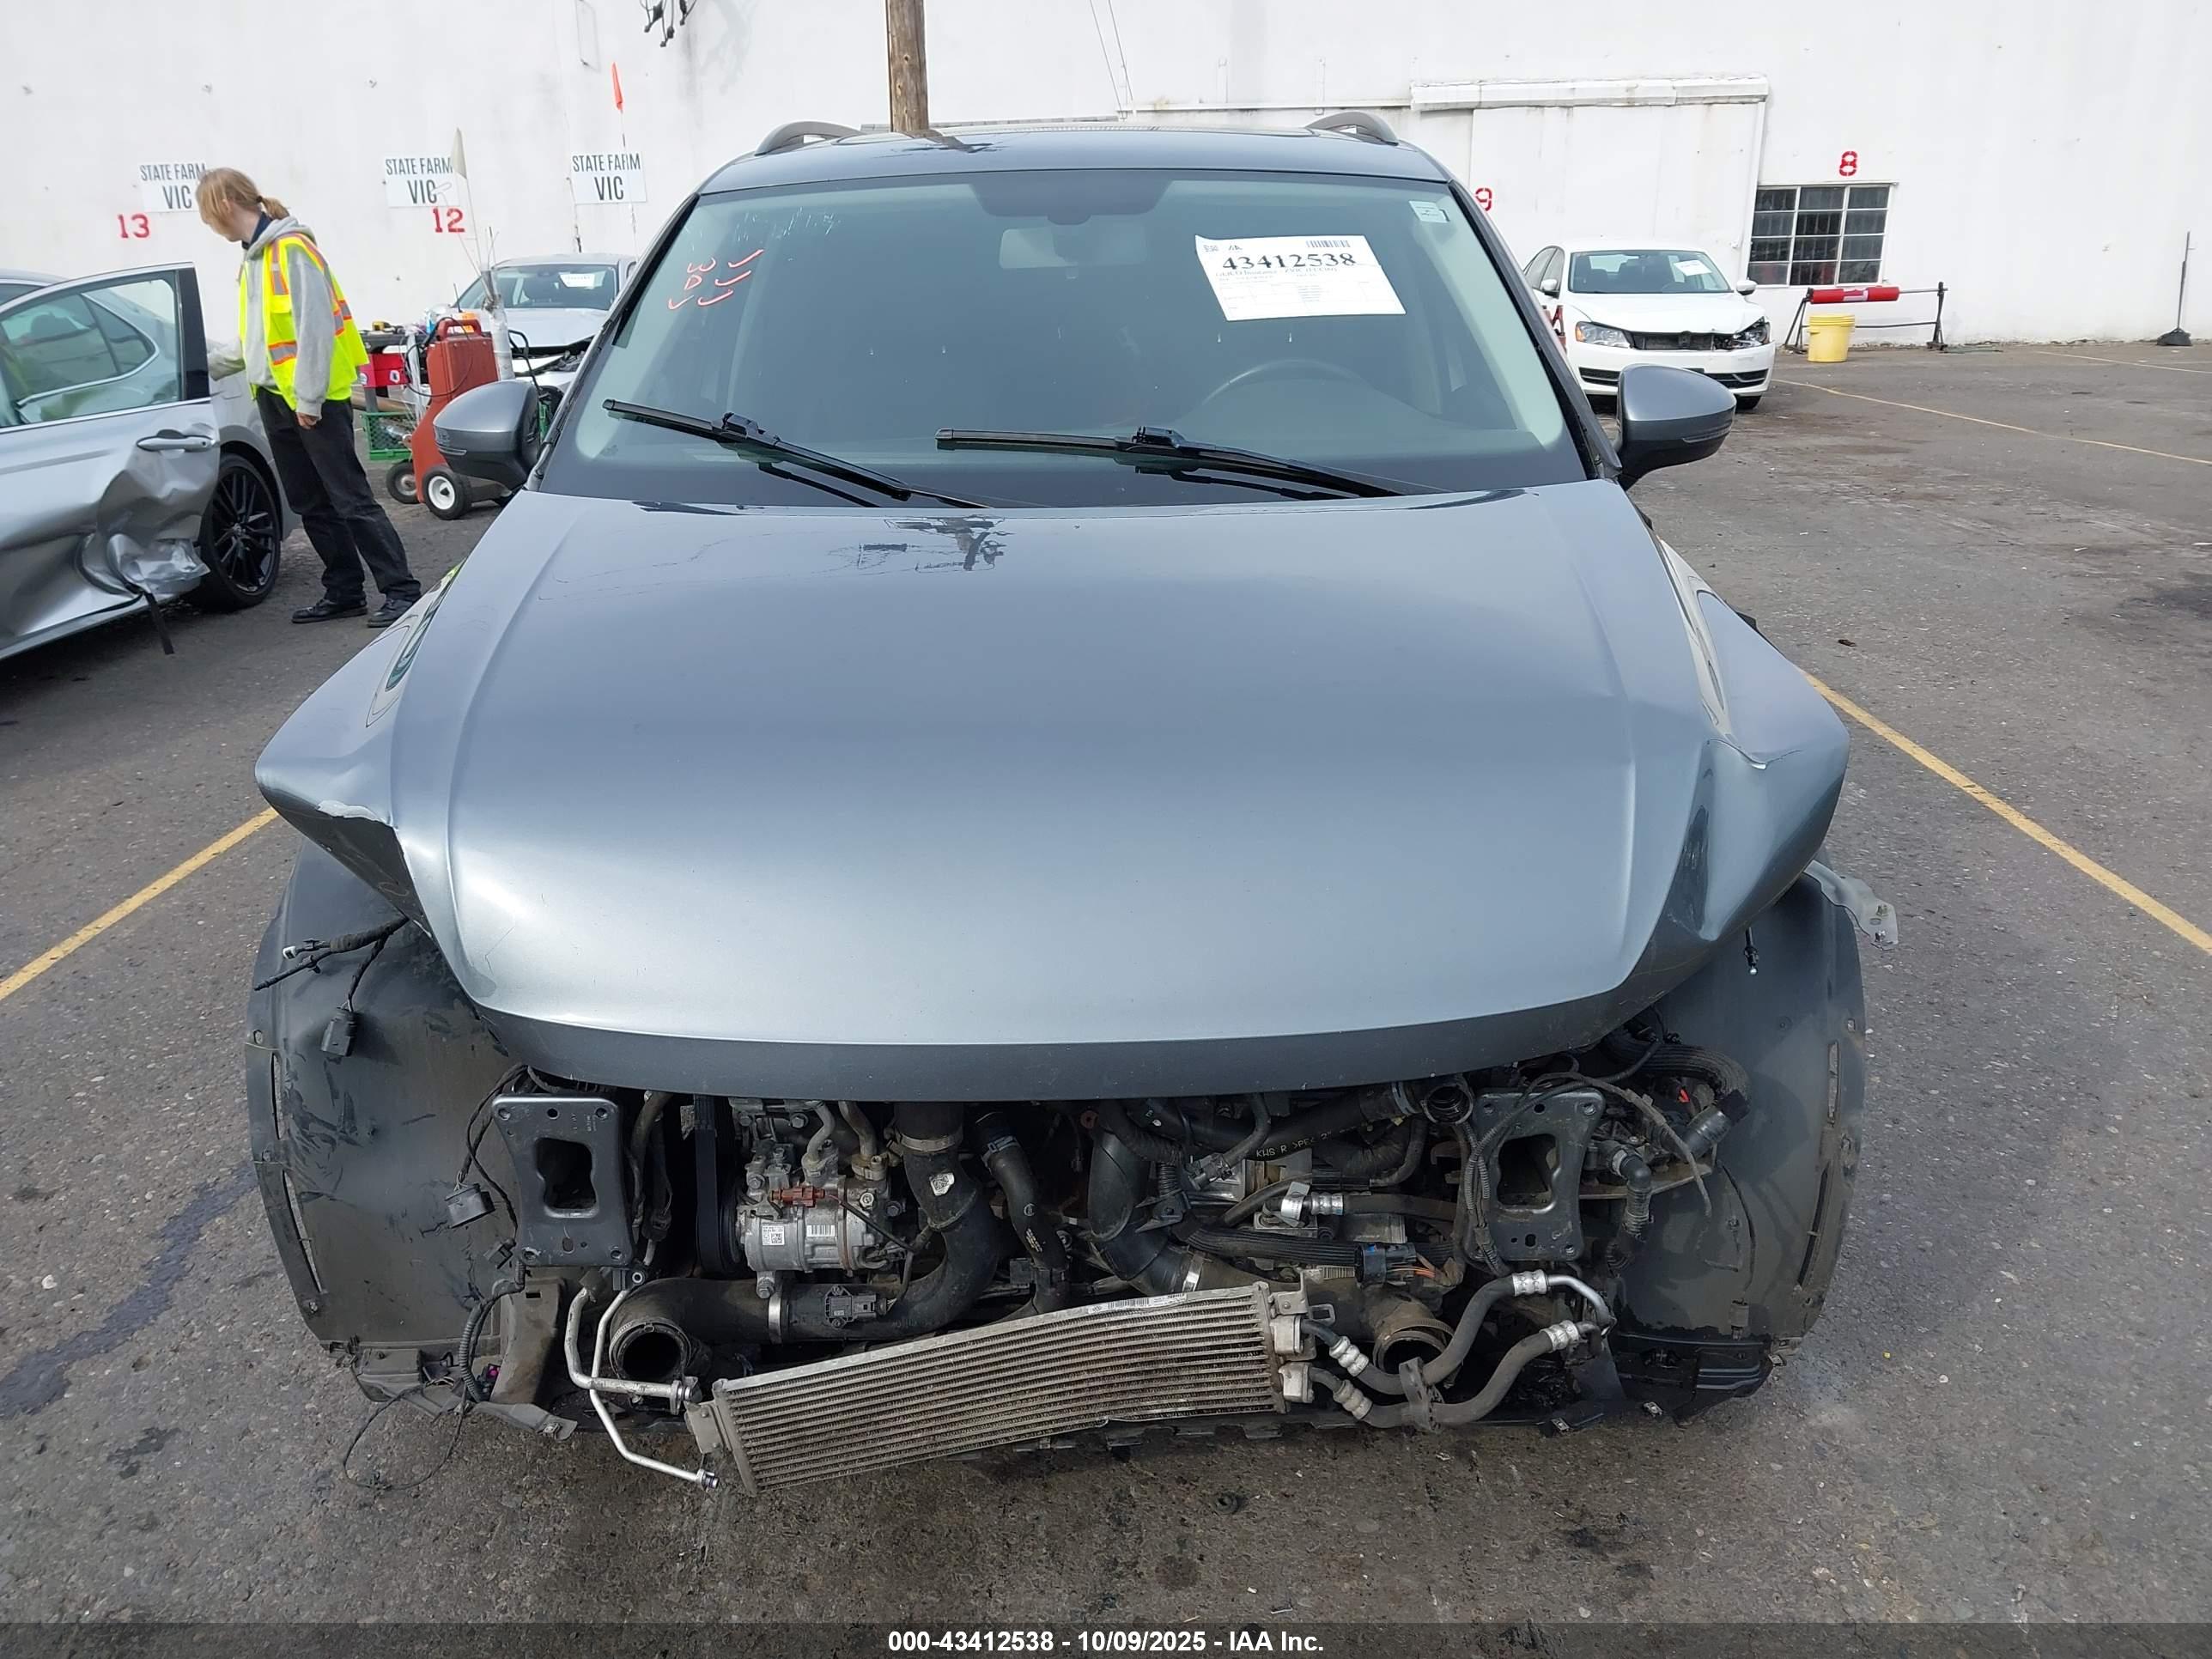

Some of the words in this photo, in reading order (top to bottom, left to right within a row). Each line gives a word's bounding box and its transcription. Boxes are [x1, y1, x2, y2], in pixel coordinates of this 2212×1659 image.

[139, 164, 172, 181] STATE
[386, 158, 417, 176] STATE
[419, 157, 453, 174] FARM
[572, 155, 605, 172] STATE
[607, 153, 641, 171] FARM
[1839, 150, 1857, 177] 8
[162, 185, 192, 210] VIC
[407, 179, 437, 204] VIC
[593, 175, 623, 201] VIC
[1475, 187, 1492, 212] 9
[118, 214, 149, 239] 13
[433, 208, 465, 233] 12
[1222, 252, 1357, 270] 43412538
